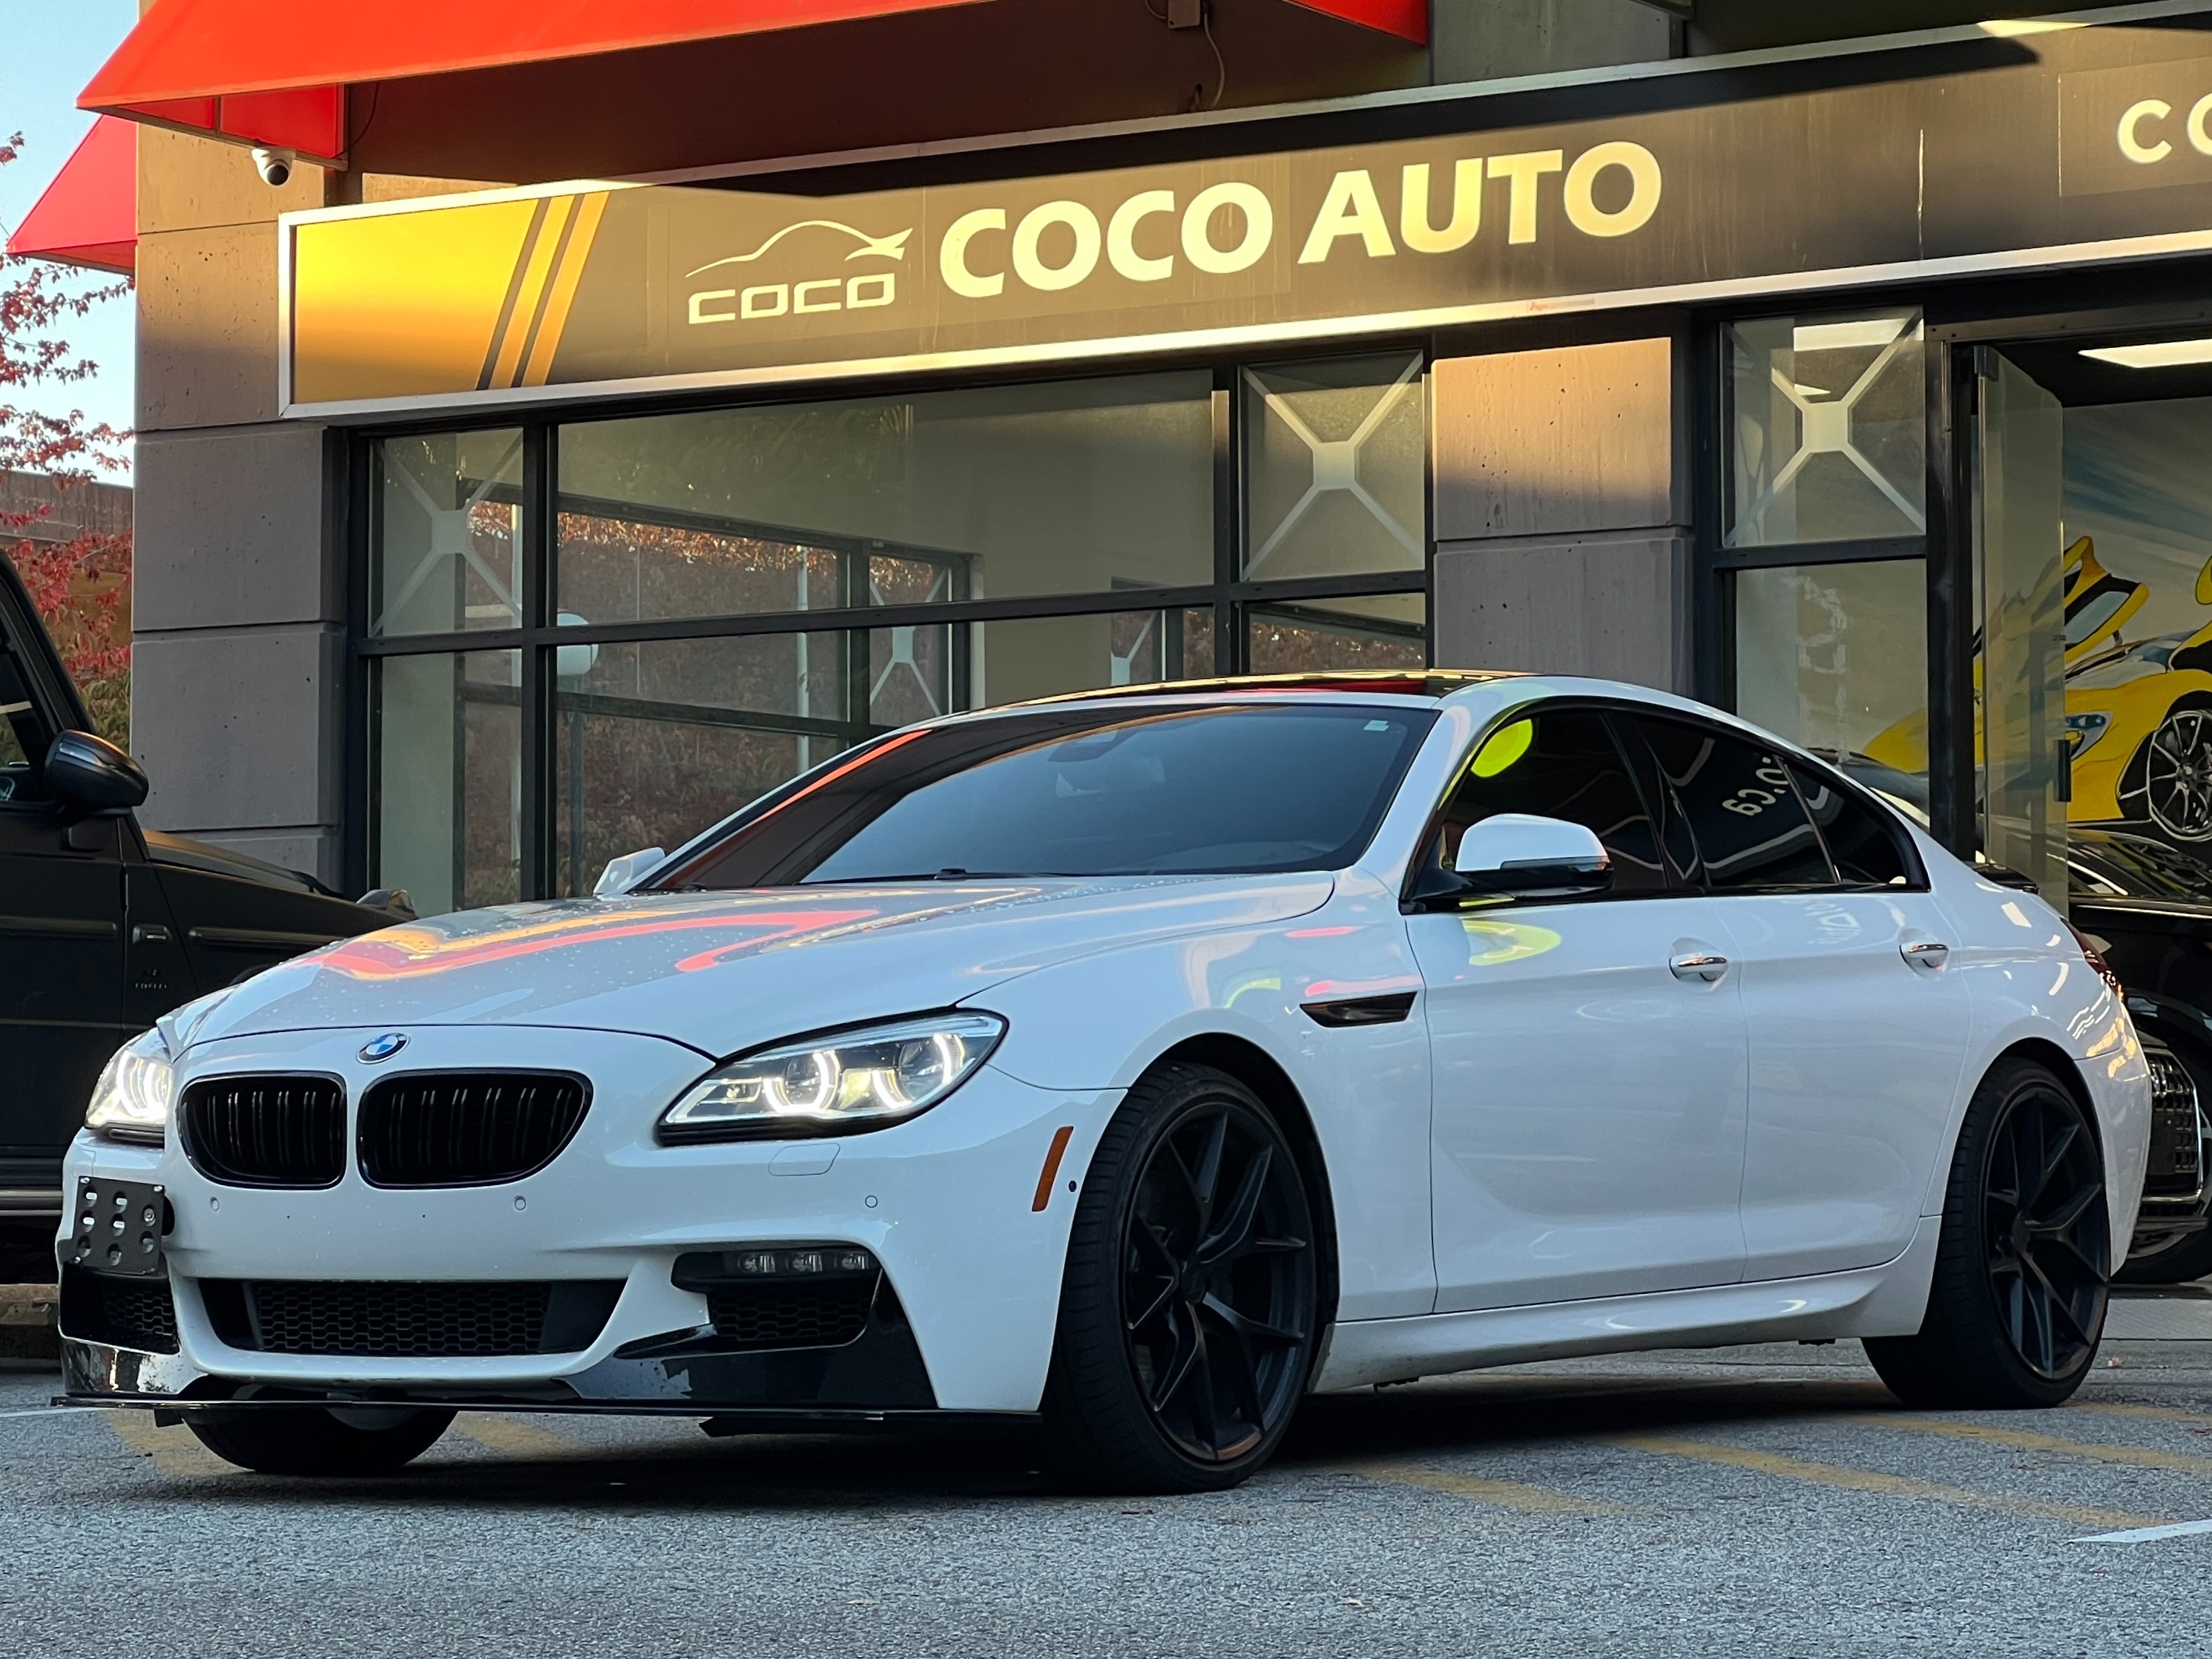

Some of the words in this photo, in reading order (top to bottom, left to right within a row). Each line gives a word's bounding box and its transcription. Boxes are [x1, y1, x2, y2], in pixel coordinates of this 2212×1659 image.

[940, 183, 1273, 298] COCO
[1298, 141, 1662, 264] AUTO
[688, 273, 895, 324] COCO
